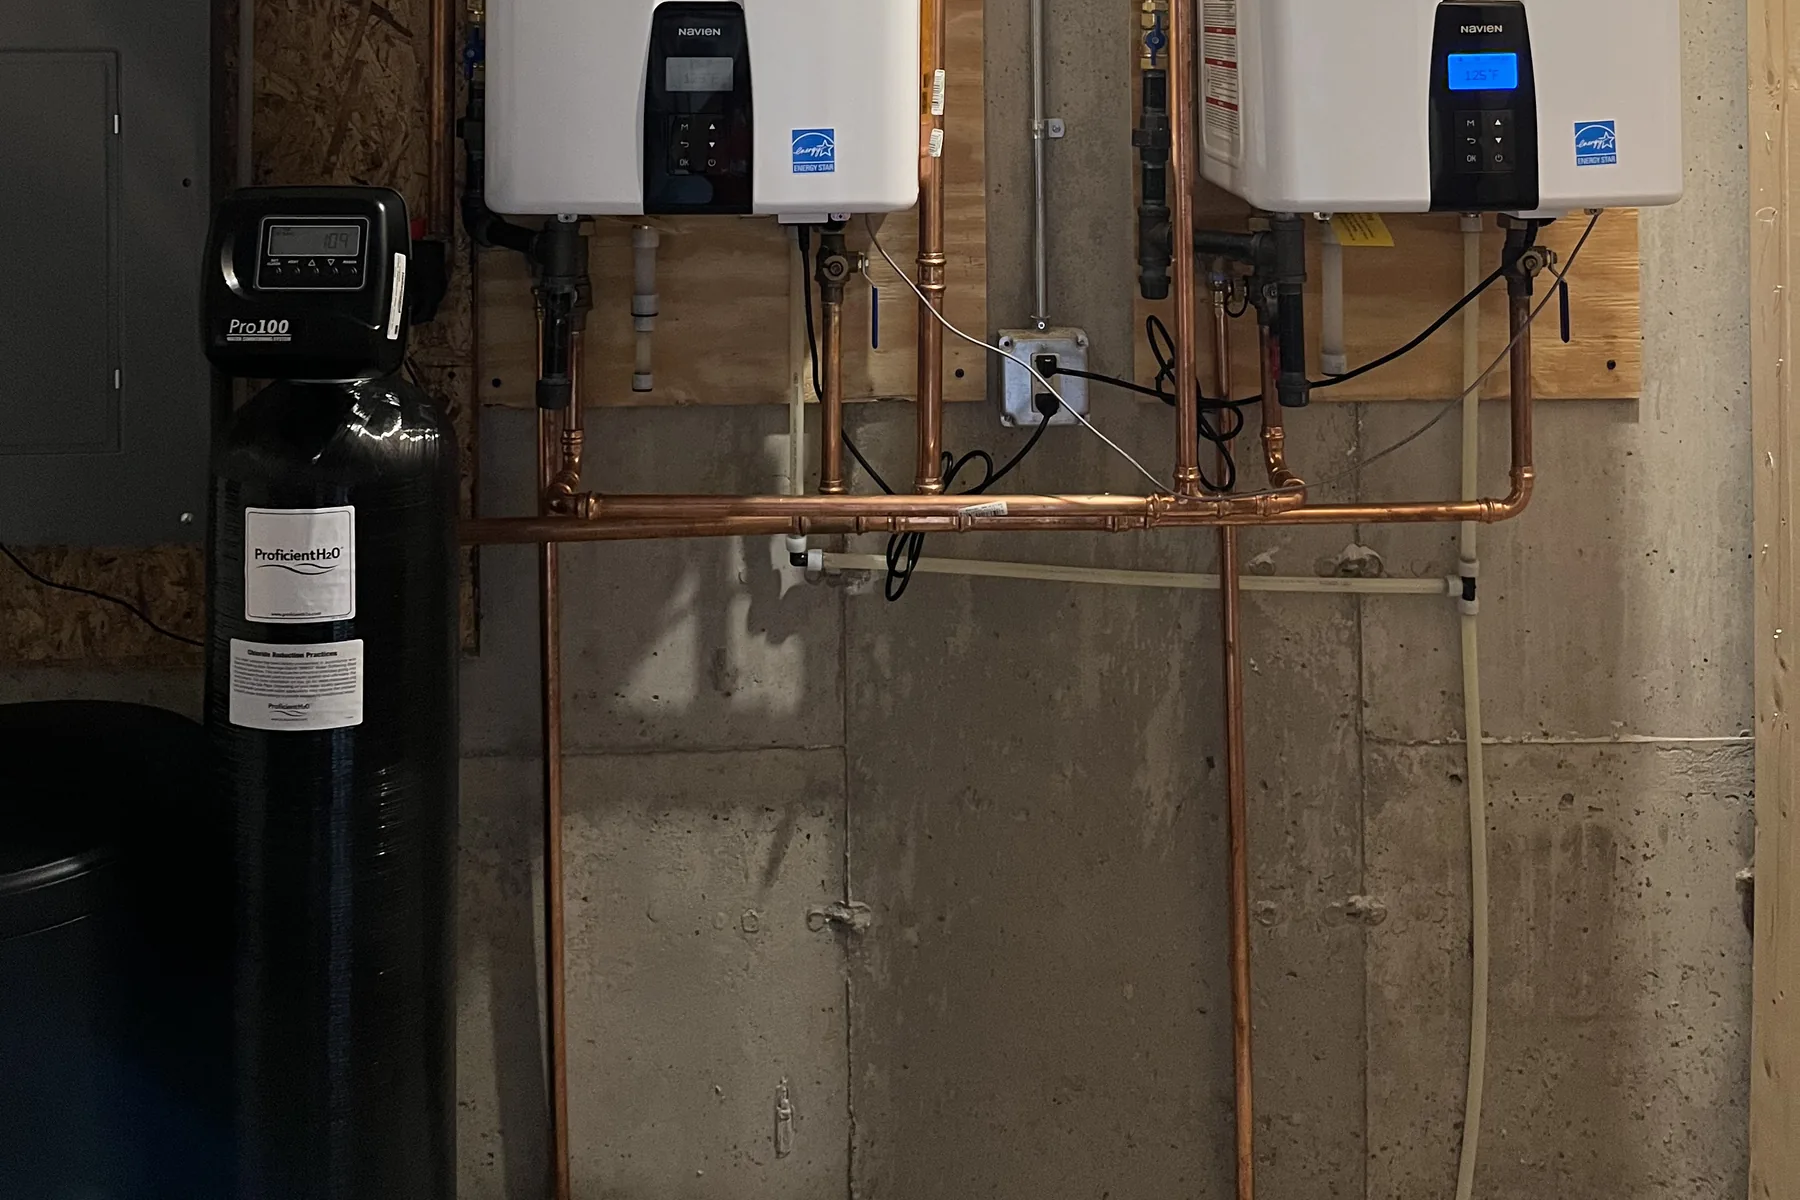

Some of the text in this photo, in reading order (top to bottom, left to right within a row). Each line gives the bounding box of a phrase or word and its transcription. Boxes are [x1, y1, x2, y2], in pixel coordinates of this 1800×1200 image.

[679, 158, 689, 166] OK
[1467, 154, 1476, 162] OK
[794, 164, 817, 172] ENERGY
[229, 319, 290, 334] Pro100
